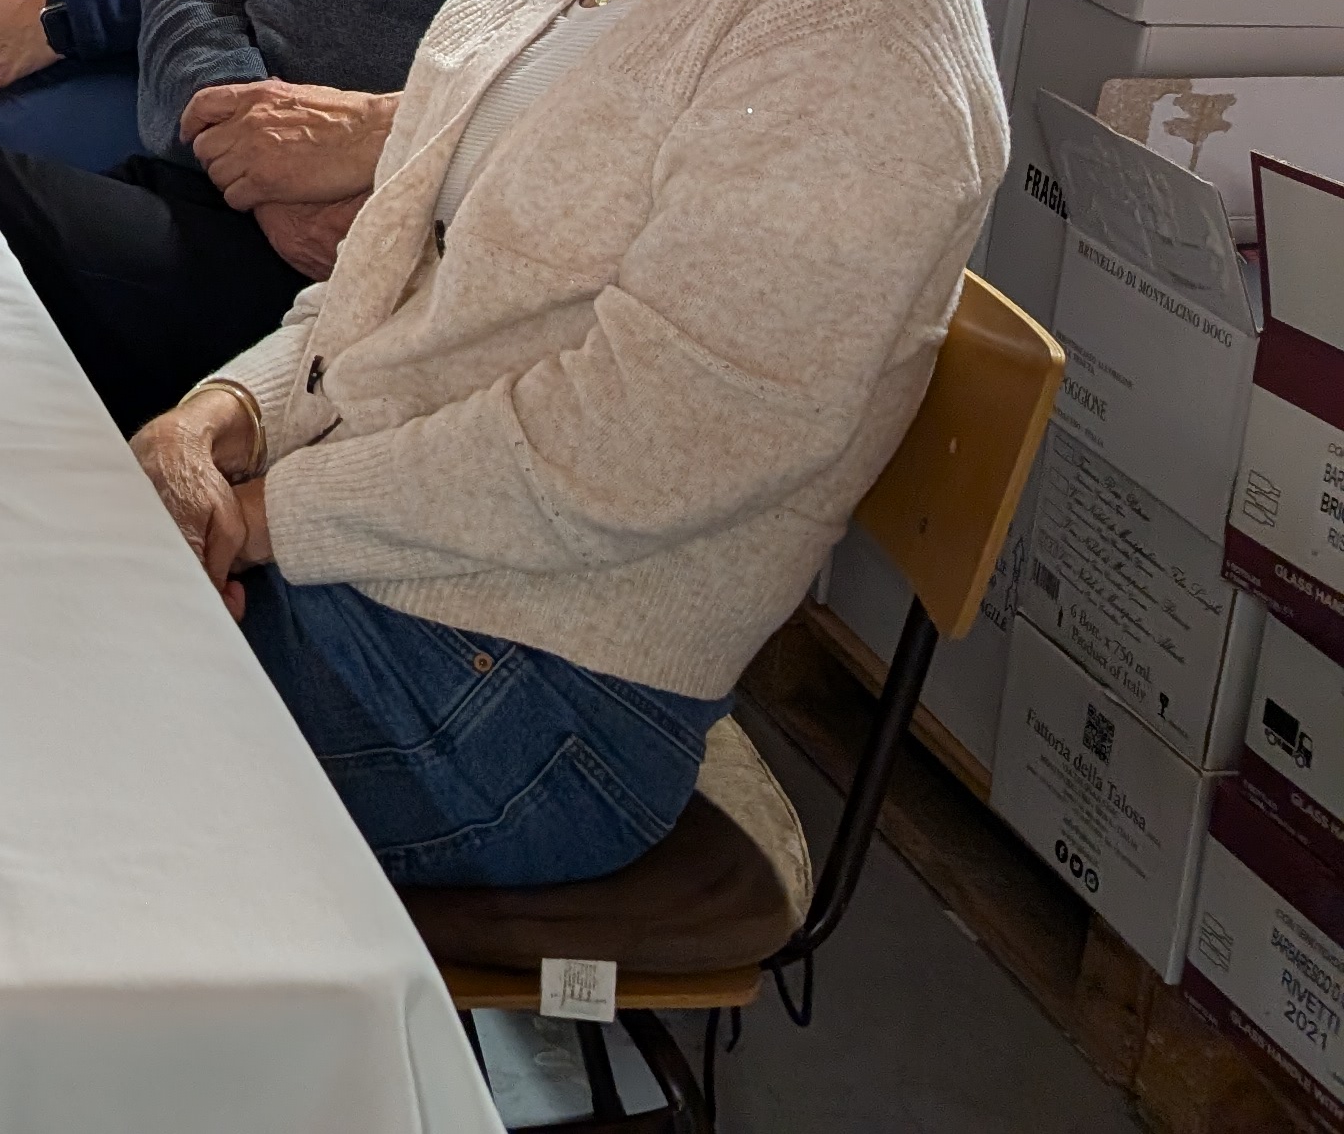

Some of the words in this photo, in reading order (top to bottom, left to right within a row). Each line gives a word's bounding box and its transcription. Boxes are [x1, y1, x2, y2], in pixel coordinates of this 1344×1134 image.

[1078, 240, 1125, 280] BRUNELLO
[1138, 279, 1200, 328] MONTALCINO
[1202, 321, 1233, 348] DOCG
[1026, 707, 1070, 762] Fattoria
[1073, 753, 1103, 792] della
[1106, 780, 1146, 833] Talosa
[1284, 1000, 1329, 1051] 2021
